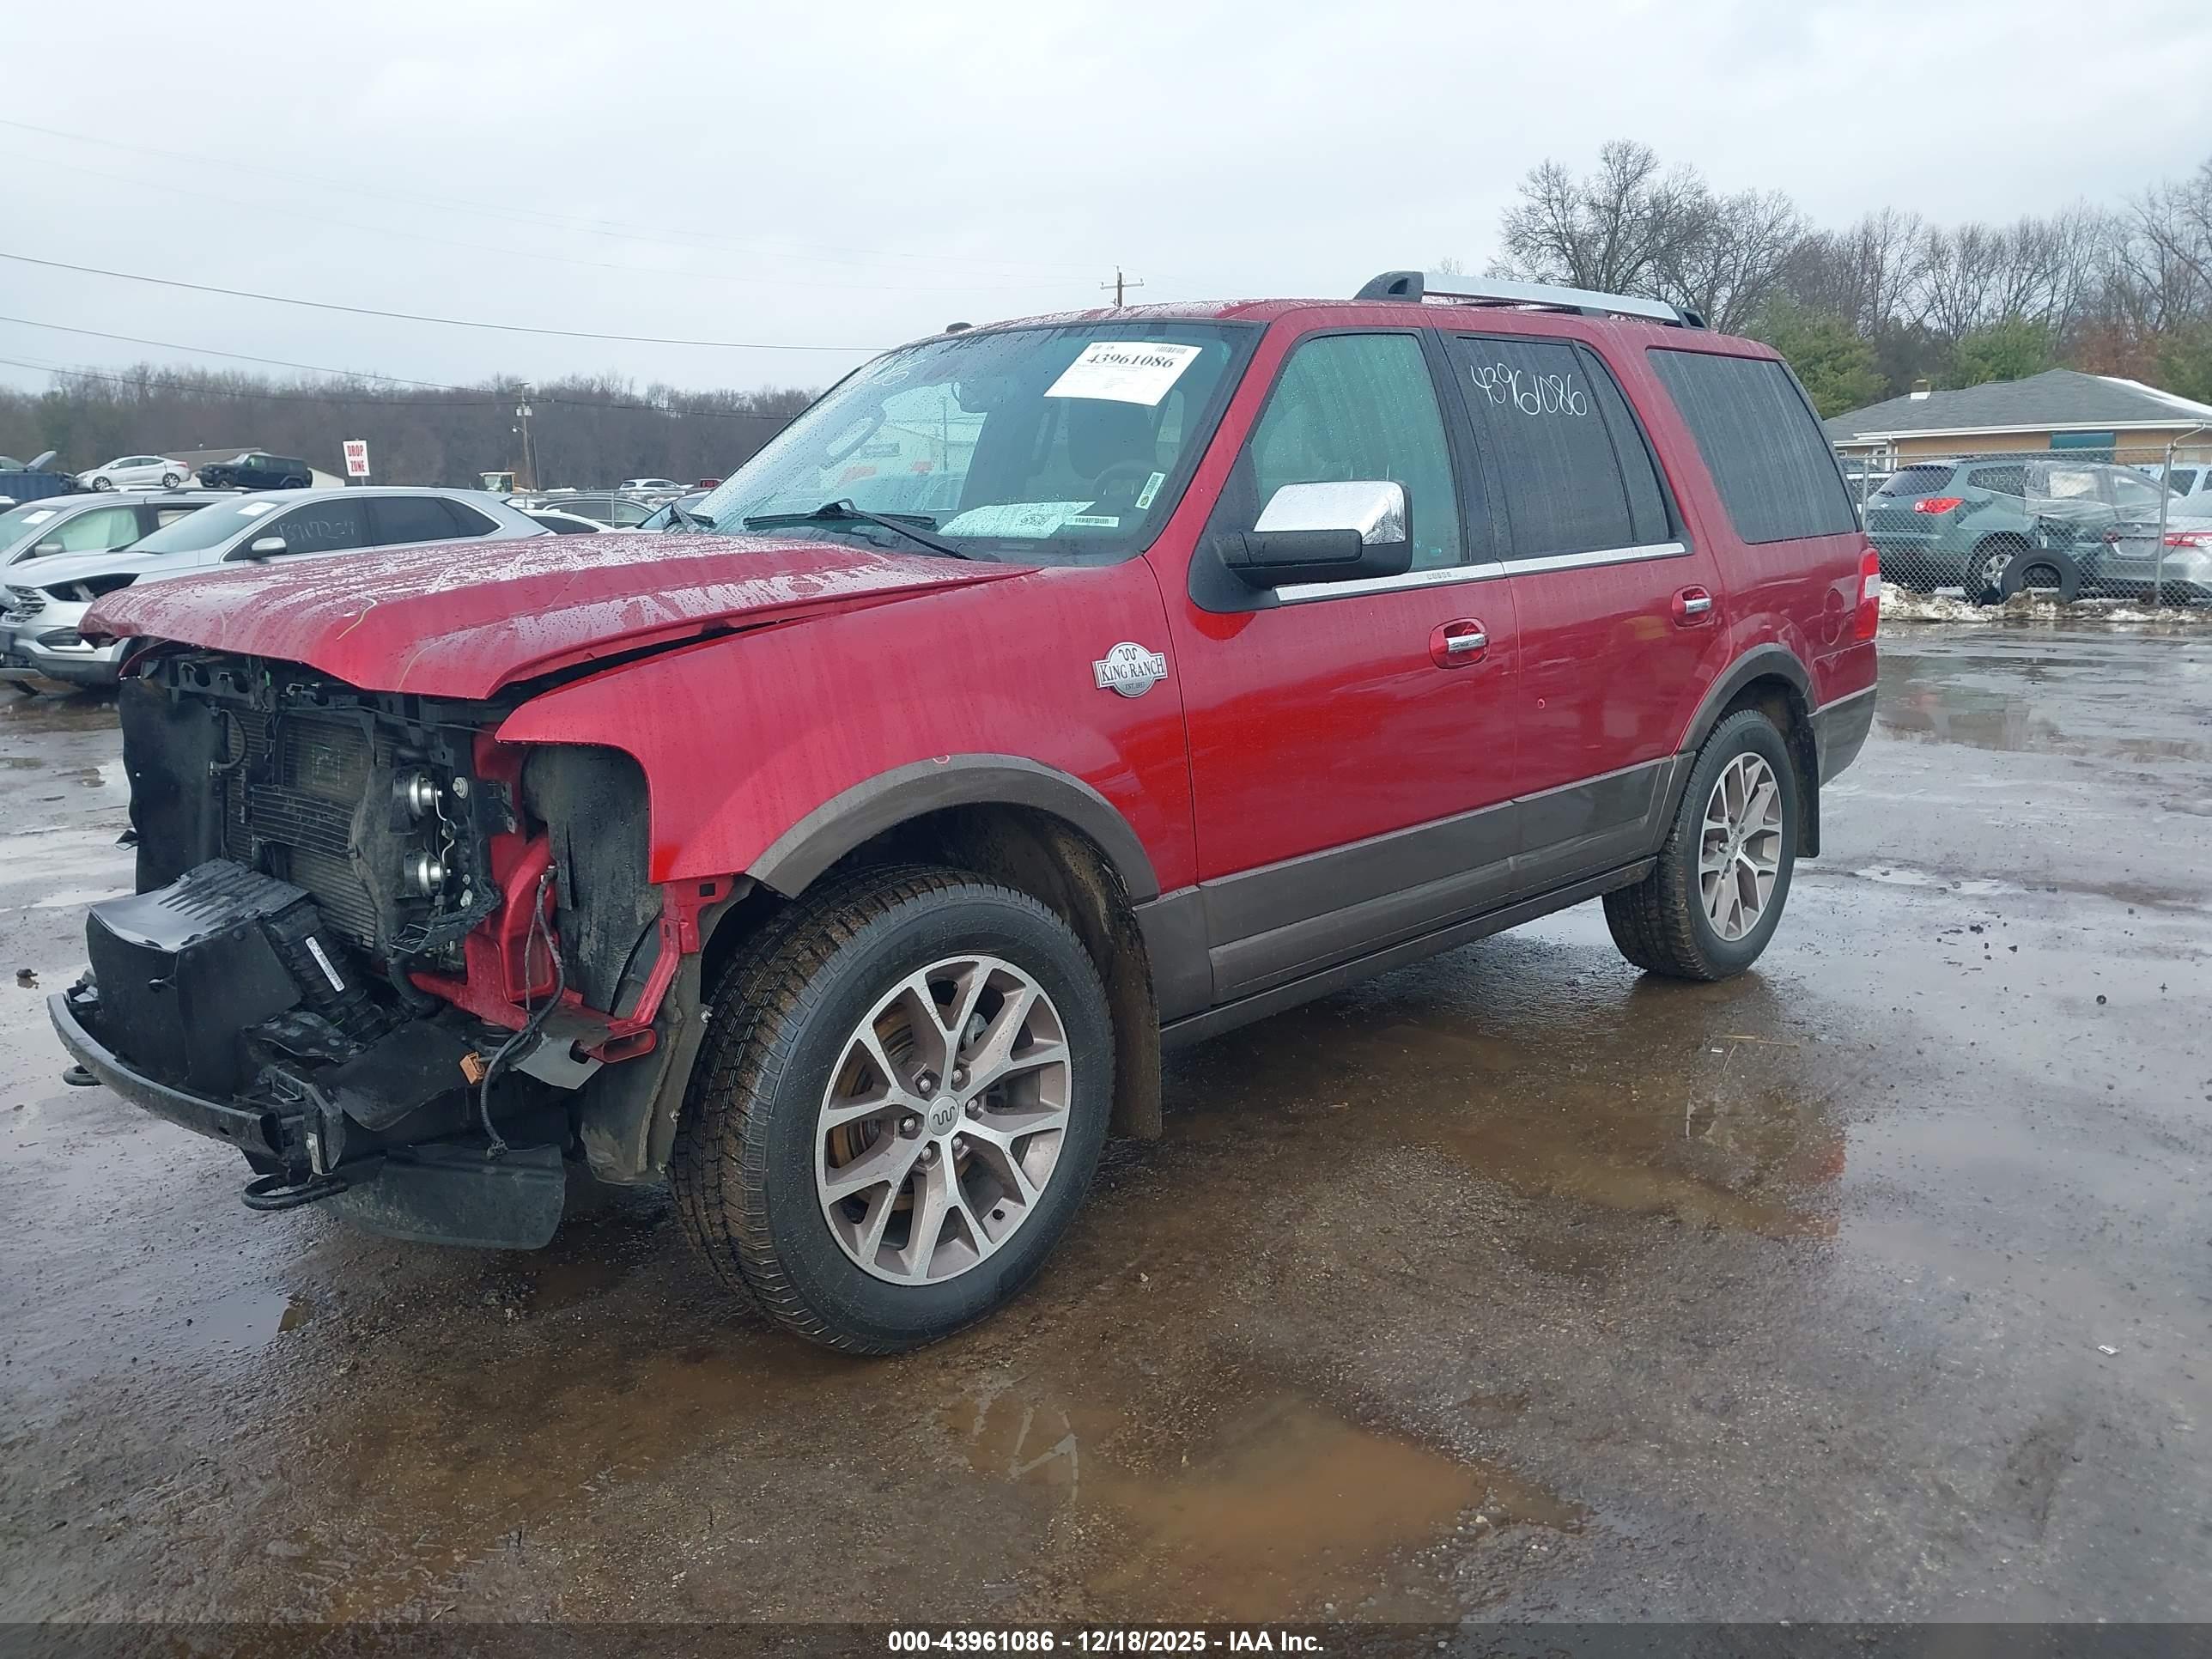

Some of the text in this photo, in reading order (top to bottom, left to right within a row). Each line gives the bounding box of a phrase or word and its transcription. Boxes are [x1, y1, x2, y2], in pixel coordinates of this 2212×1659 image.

[1086, 353, 1178, 368] 43961086
[1470, 362, 1588, 416] 43961086
[347, 444, 364, 457] DROP
[350, 459, 366, 472] ZONE
[1100, 658, 1164, 681] KING RANCH
